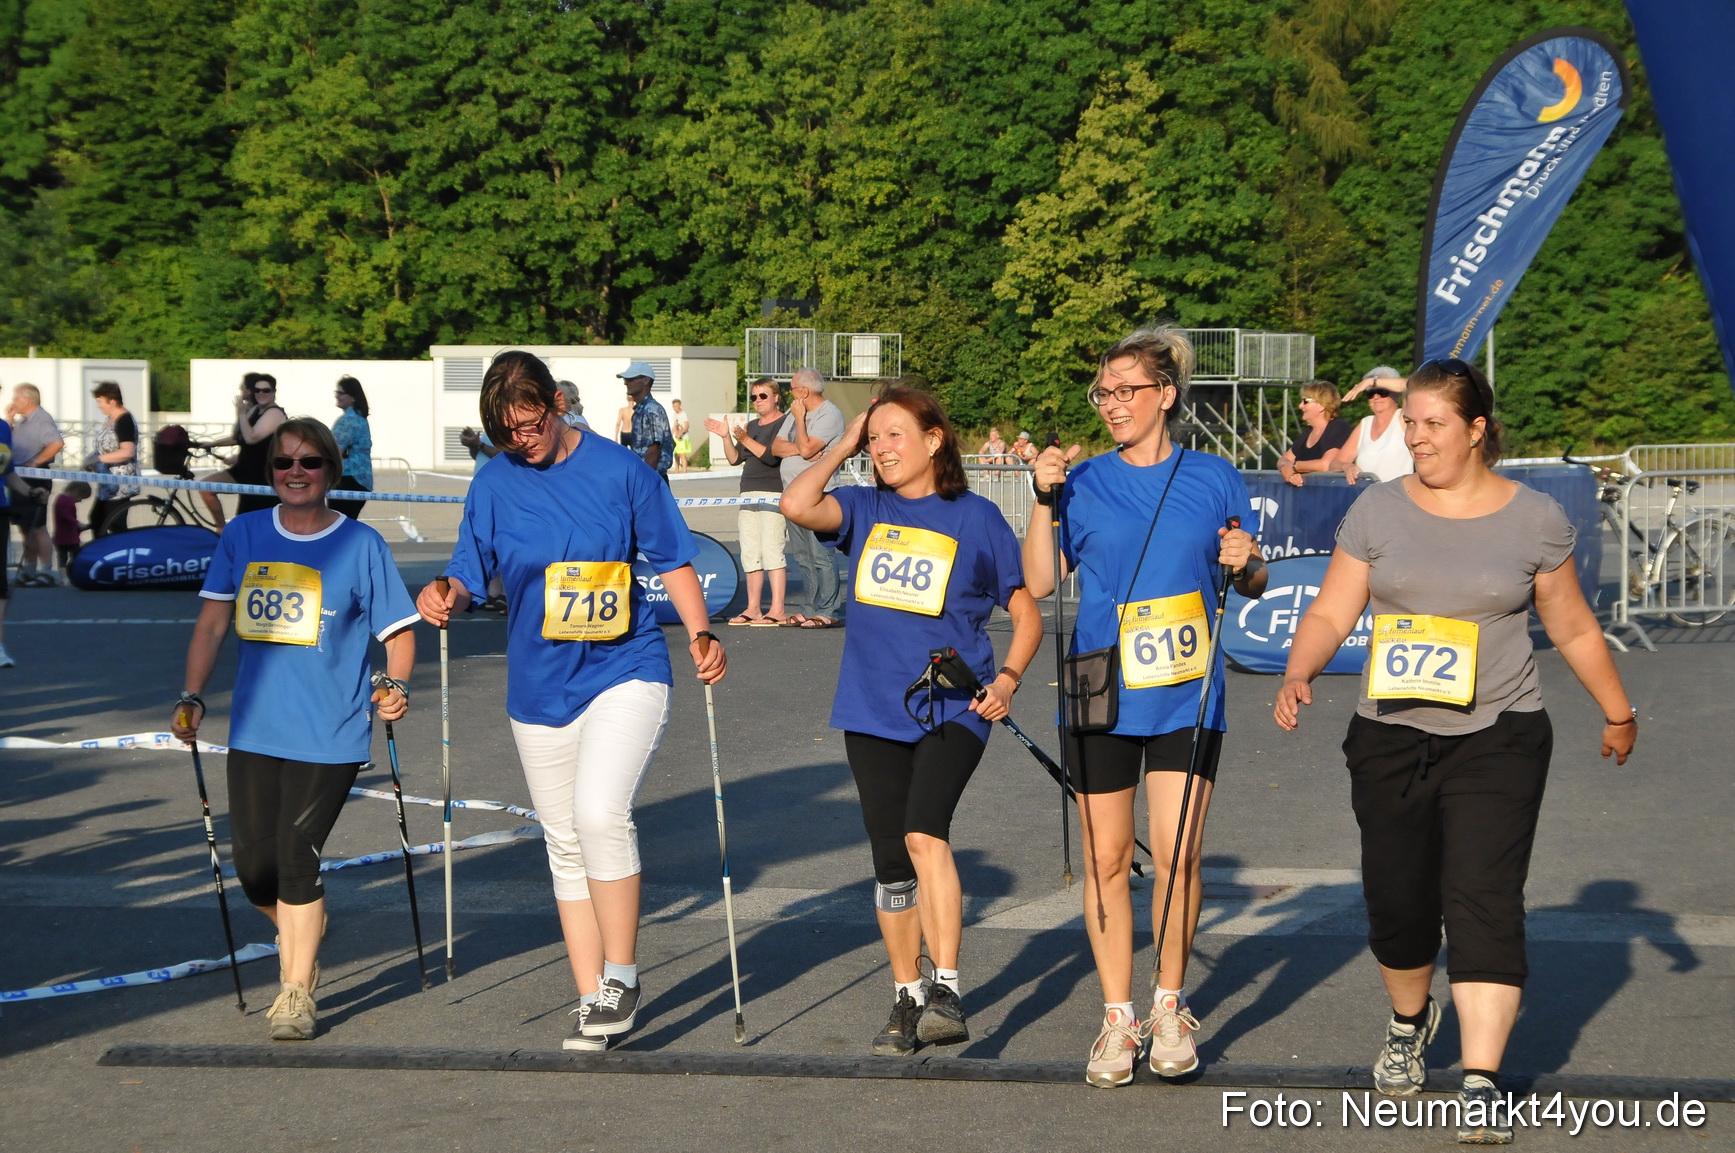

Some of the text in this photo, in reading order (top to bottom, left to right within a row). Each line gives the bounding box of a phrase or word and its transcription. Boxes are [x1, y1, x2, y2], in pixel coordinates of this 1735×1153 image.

[1525, 156, 1563, 199] Druck
[1434, 126, 1567, 305] Frischmann
[113, 556, 211, 581] Fischer
[870, 552, 934, 592] 648
[246, 588, 305, 624] 683
[559, 590, 618, 622] 718
[1133, 624, 1198, 666] 619
[1385, 643, 1458, 682] 672
